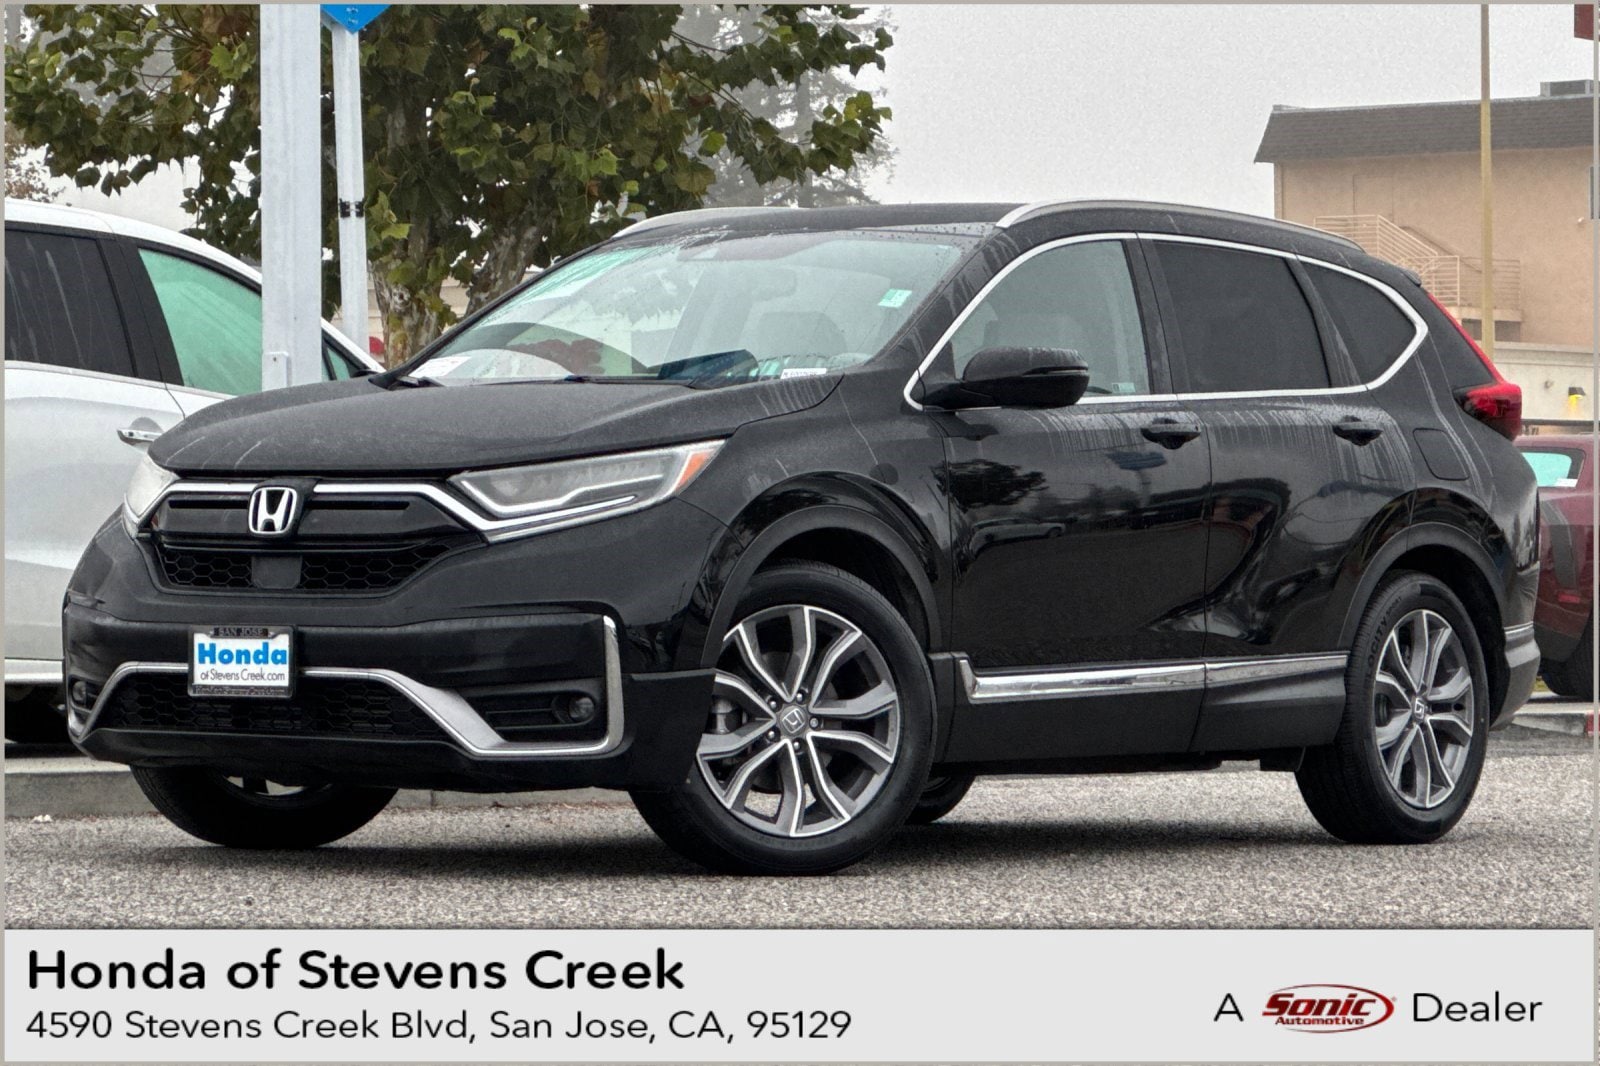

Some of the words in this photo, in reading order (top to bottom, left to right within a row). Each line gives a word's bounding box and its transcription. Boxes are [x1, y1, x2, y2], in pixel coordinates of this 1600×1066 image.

[219, 627, 237, 636] SAN
[198, 642, 287, 665] Honda
[200, 670, 210, 681] of
[210, 668, 240, 681] Stevens
[240, 667, 286, 681] Creek.com
